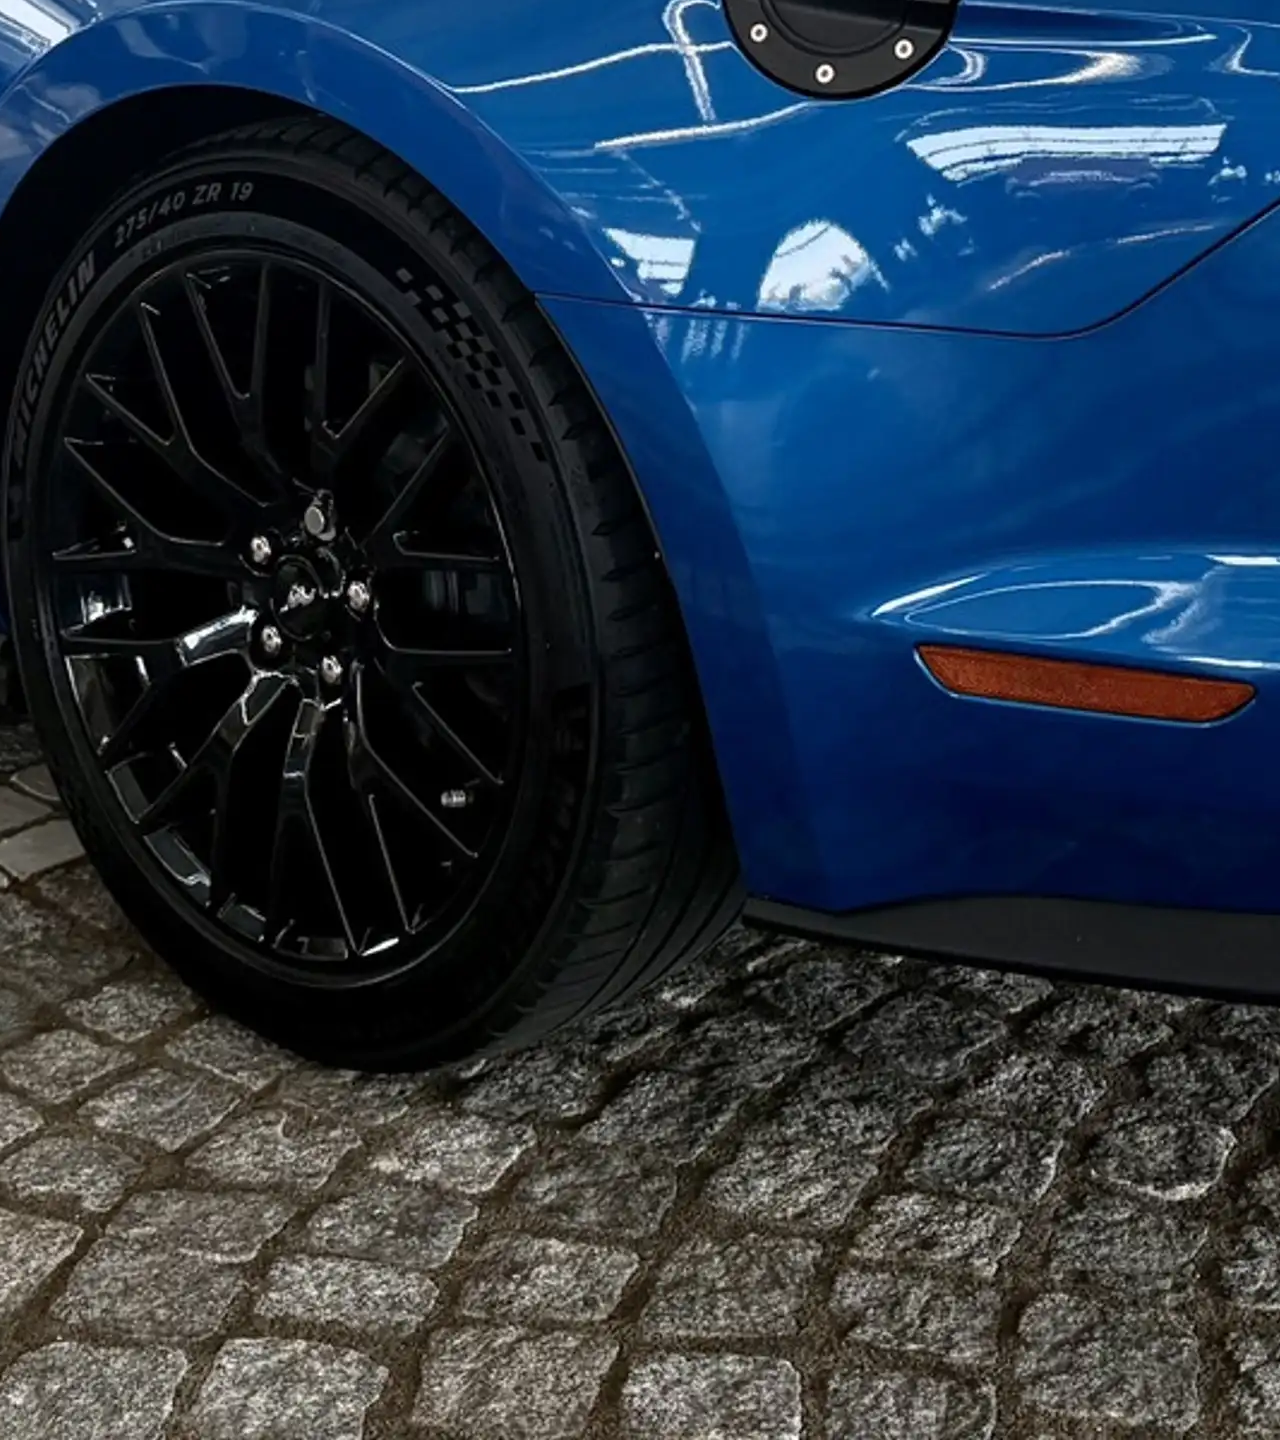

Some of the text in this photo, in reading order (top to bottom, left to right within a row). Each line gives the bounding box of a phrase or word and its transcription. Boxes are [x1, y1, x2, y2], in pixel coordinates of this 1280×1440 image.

[11, 248, 98, 472] MICHELIN
[191, 181, 224, 206] ZR
[229, 180, 256, 203] 19
